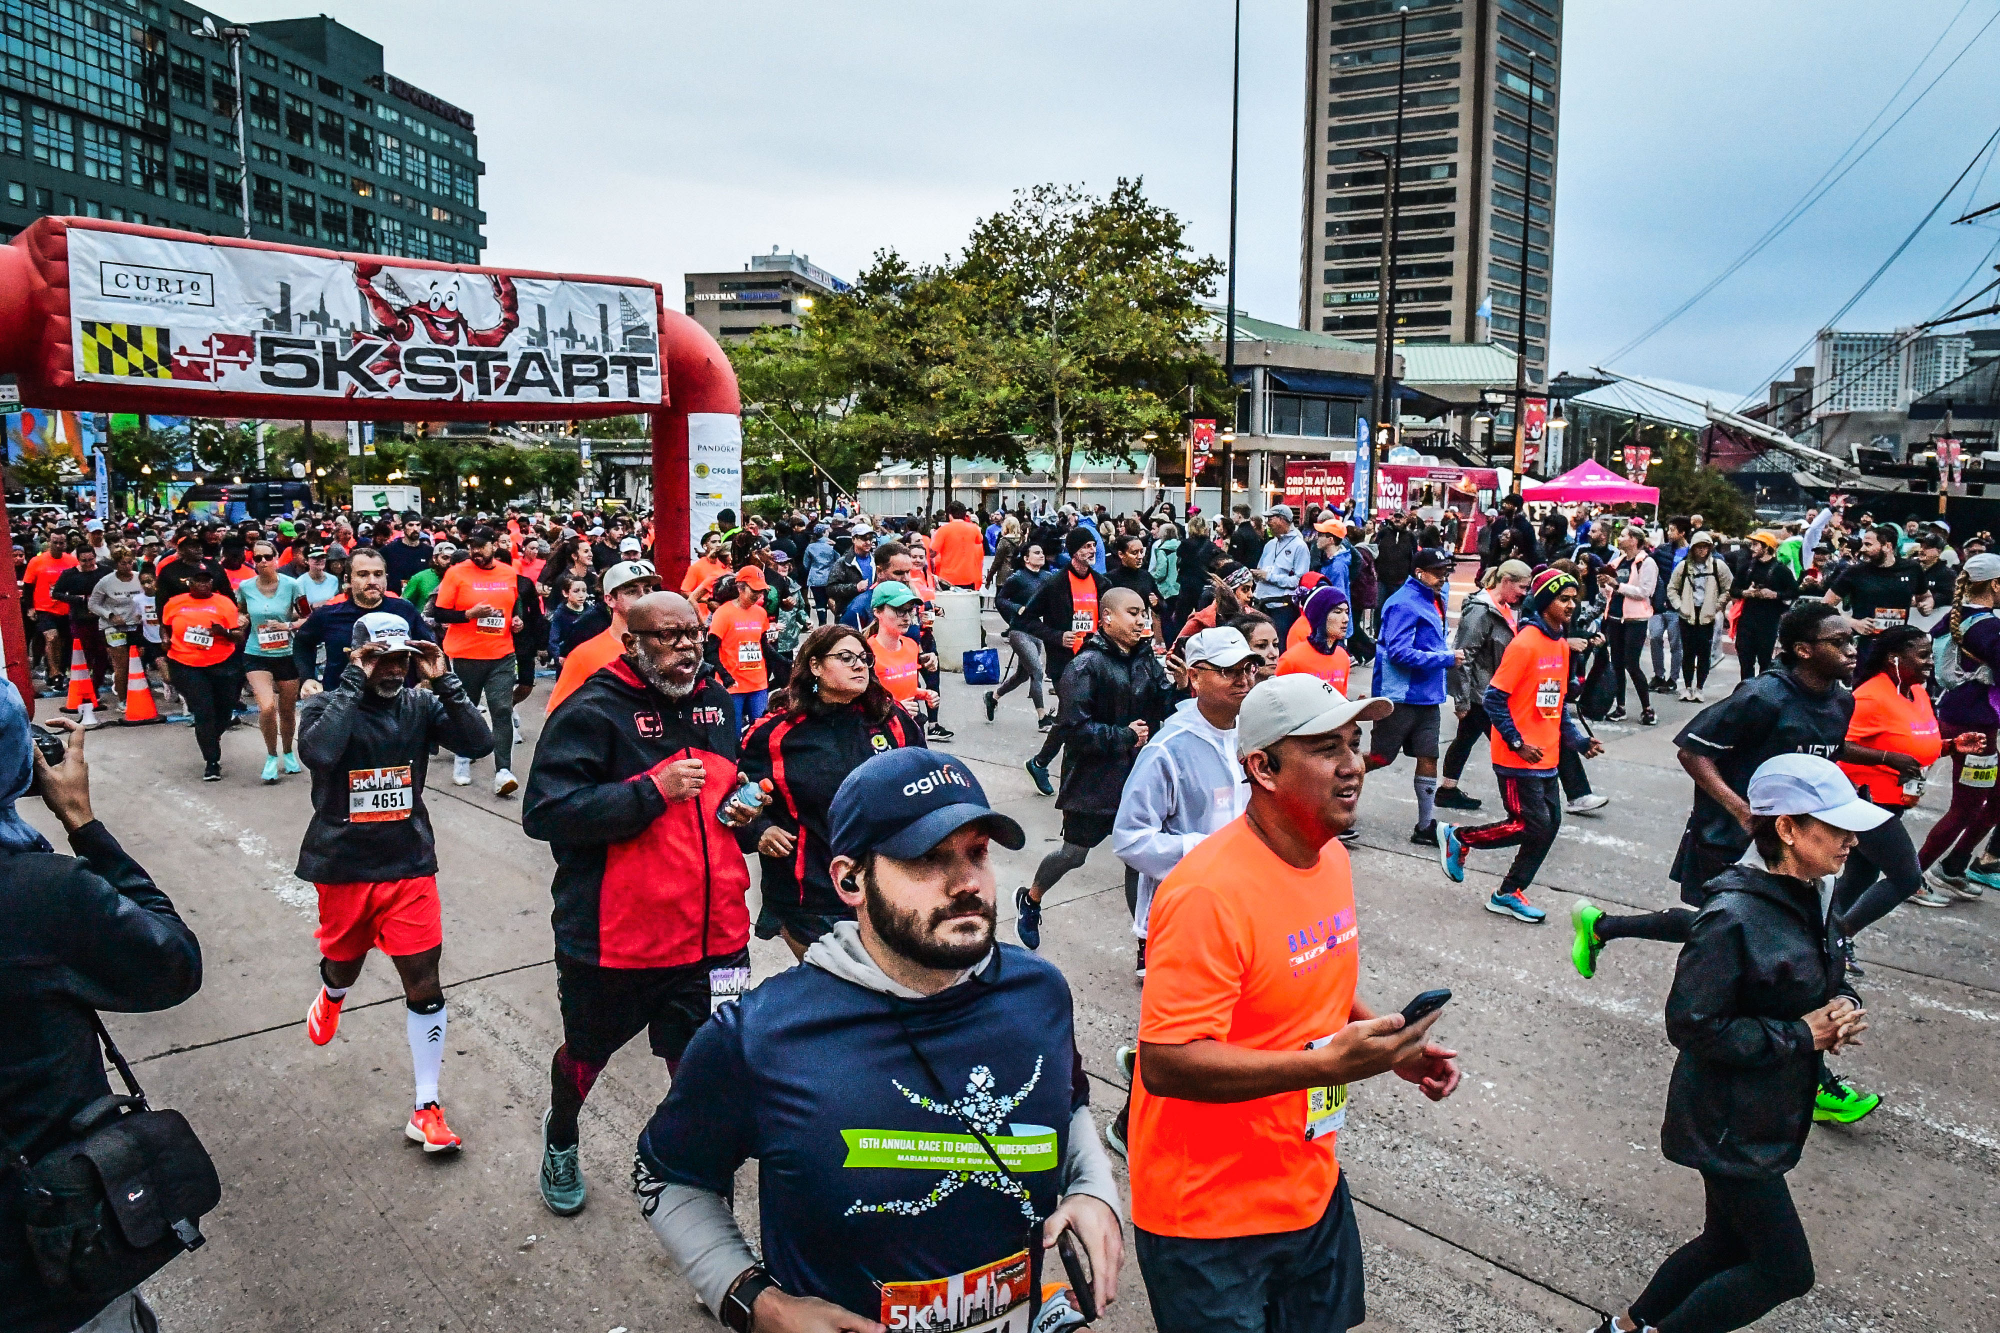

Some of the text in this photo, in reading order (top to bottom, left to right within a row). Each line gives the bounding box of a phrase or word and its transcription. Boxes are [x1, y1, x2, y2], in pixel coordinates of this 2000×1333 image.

[694, 292, 737, 301] SILVERMAN
[260, 336, 655, 399] 5K START
[711, 467, 739, 475] CFG Bank
[1286, 476, 1346, 486] ORDER AHEAD.
[1285, 486, 1346, 496] SKIP THE WAIT.
[1380, 483, 1403, 496] YOU
[353, 778, 369, 790] 5K
[371, 791, 406, 809] 4651
[859, 1137, 880, 1149] 15TH
[881, 1138, 916, 1151] ANNUAL
[918, 1140, 941, 1152] RACE
[943, 1141, 953, 1153] TO
[997, 1142, 1053, 1155] INDEPENDENCE
[897, 1154, 928, 1163] MARIAN
[888, 1304, 934, 1331] 5K
[1037, 1307, 1067, 1333] HOKA
